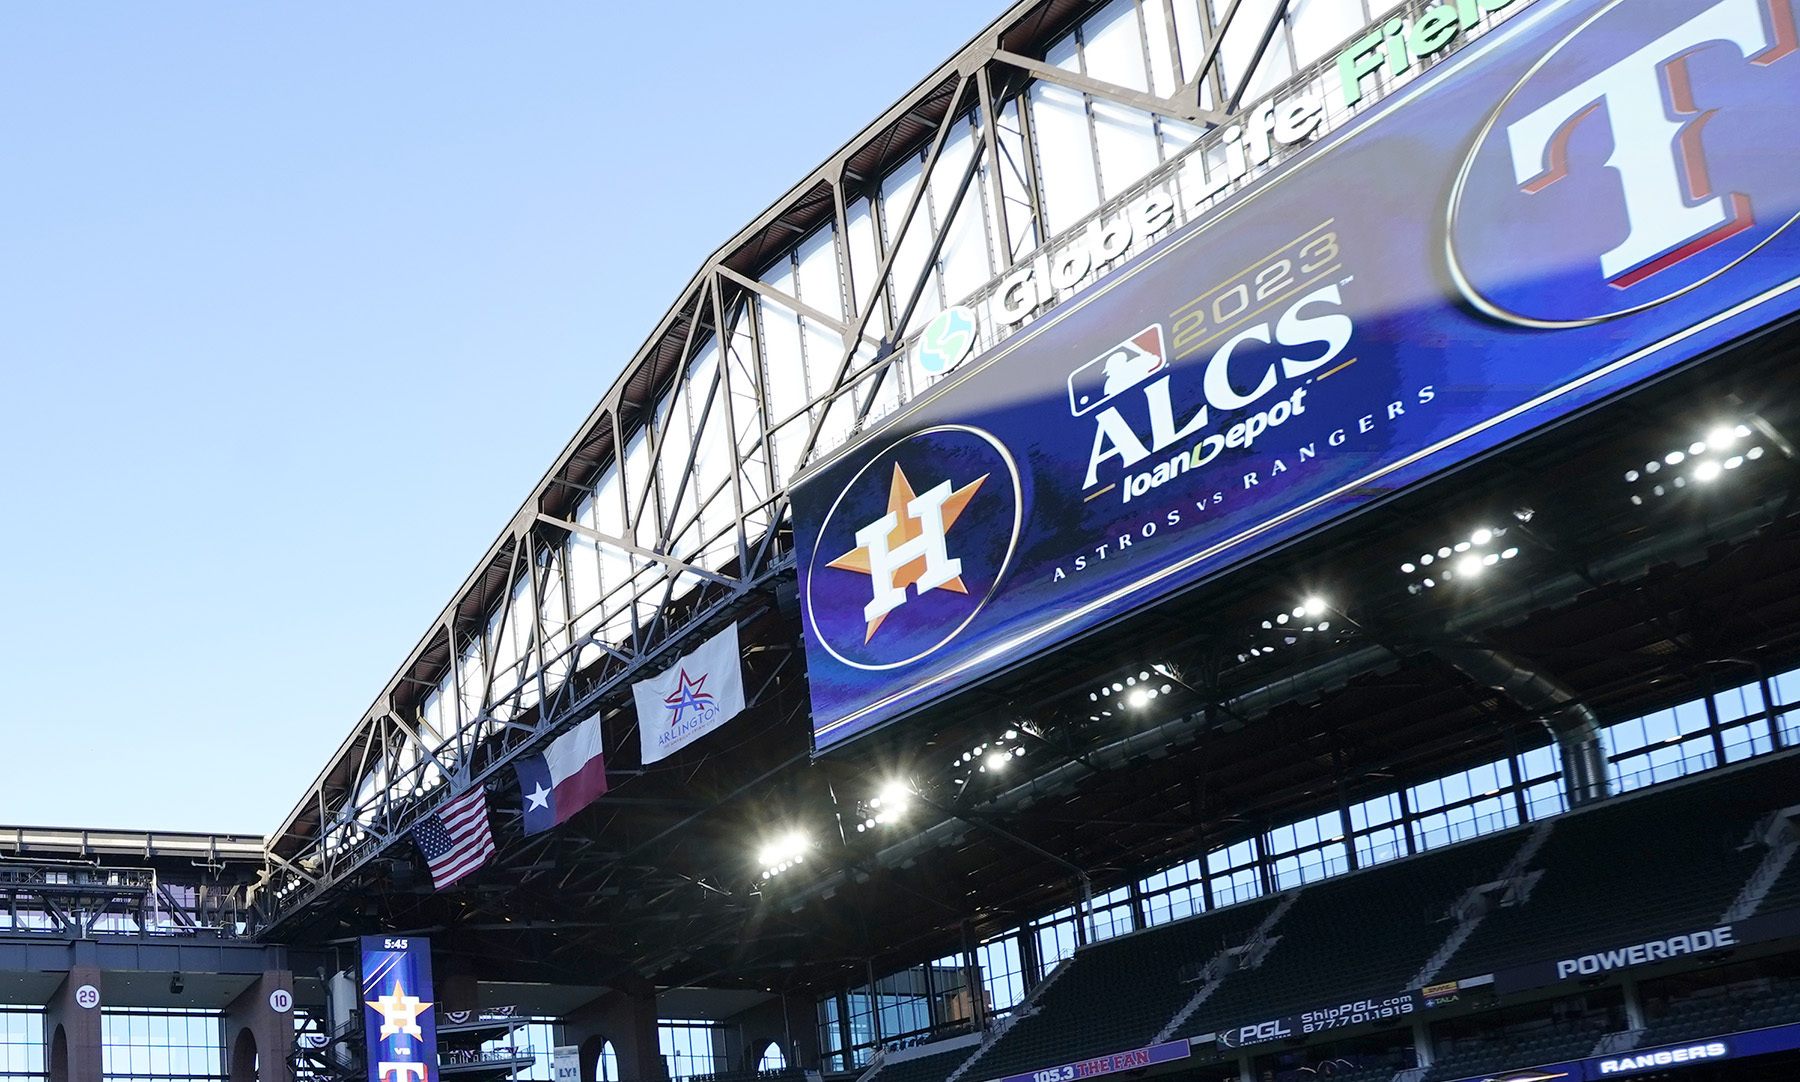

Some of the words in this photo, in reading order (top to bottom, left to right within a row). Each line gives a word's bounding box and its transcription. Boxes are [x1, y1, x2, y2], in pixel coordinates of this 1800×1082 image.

[995, 188, 1176, 325] Globe
[1185, 94, 1324, 206] Life
[1172, 232, 1340, 349] 2023
[1082, 283, 1353, 491] ALCS
[1122, 380, 1312, 503] loanDepot
[1053, 510, 1181, 582] ASTROS
[1243, 385, 1436, 490] RANGERS
[862, 478, 963, 622] H
[658, 703, 721, 747] ARLINGTON
[384, 938, 408, 949] 5:45
[1557, 926, 1735, 980] POWERADE
[78, 989, 97, 1004] 29
[274, 994, 287, 1009] 10
[378, 995, 422, 1034] H
[1301, 994, 1412, 1023] ShipPGL.com
[1239, 1020, 1291, 1043] PGL
[1303, 1003, 1414, 1033] 877.701.1919
[1076, 1057, 1111, 1076] THE
[1113, 1049, 1151, 1071] FAN
[1601, 1041, 1725, 1075] RANGERS
